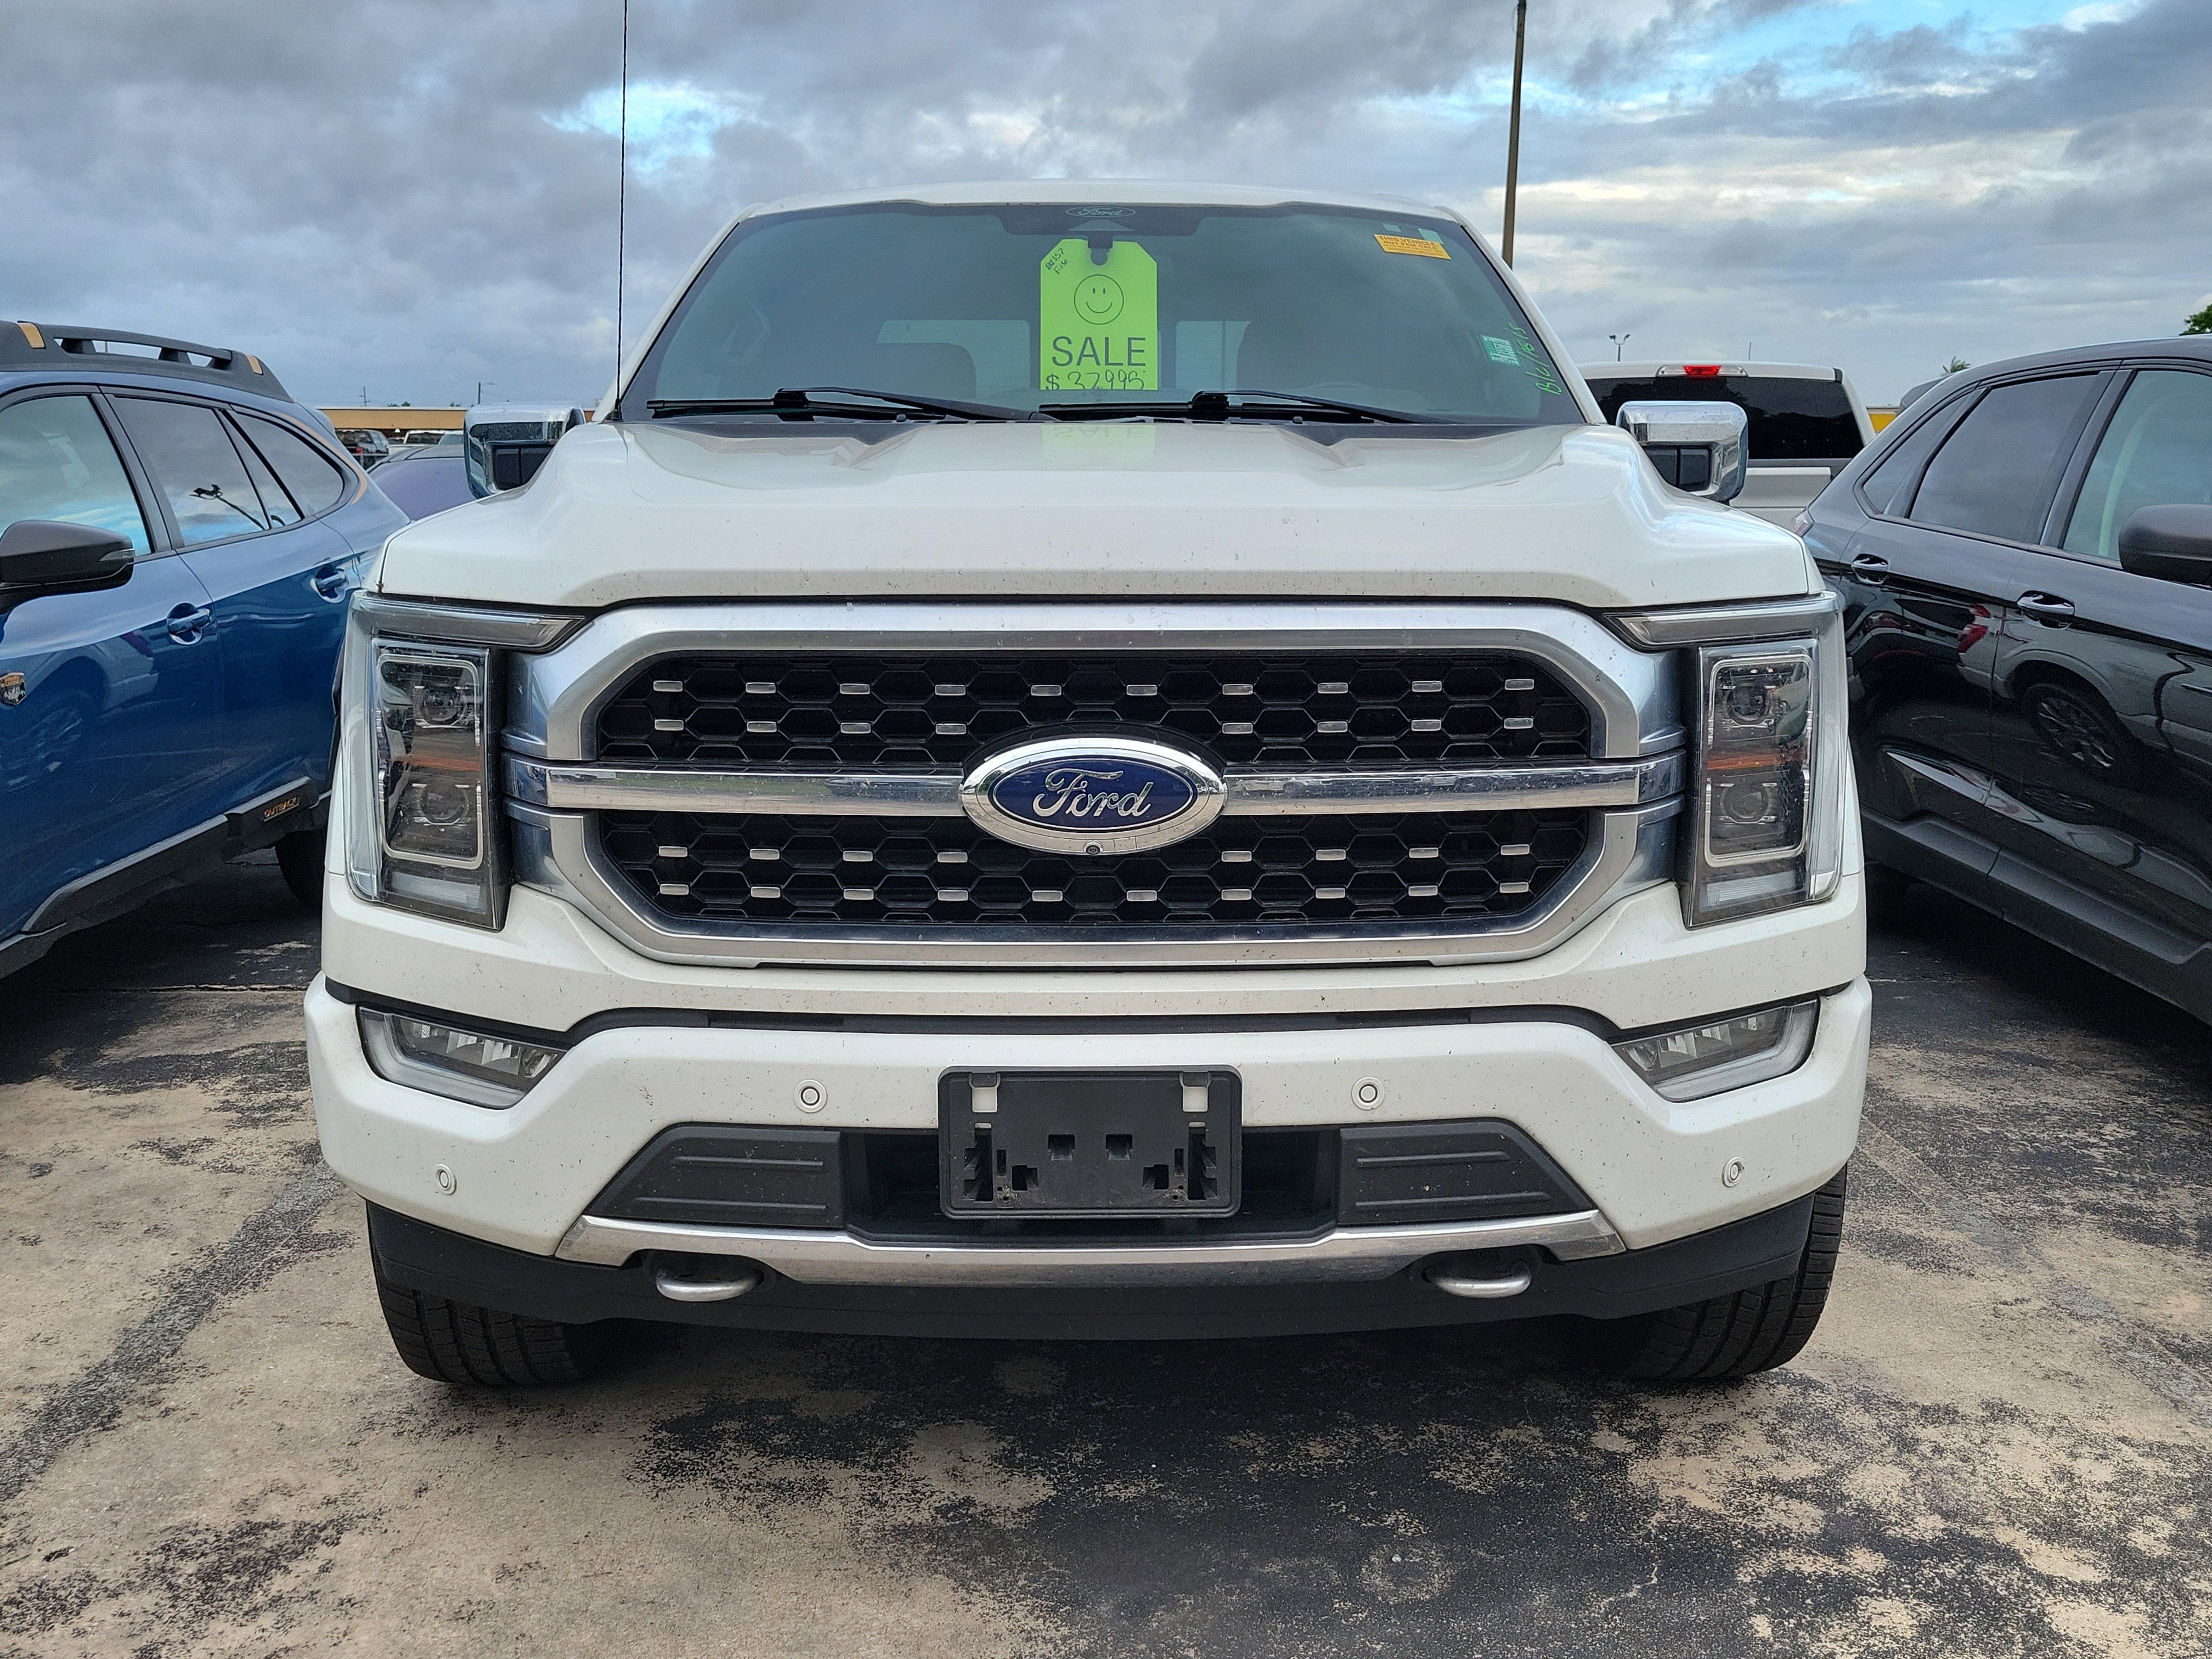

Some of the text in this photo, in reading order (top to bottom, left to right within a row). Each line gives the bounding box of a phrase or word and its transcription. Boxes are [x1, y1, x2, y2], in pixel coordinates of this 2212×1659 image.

[1078, 207, 1124, 216] Ford
[1052, 336, 1146, 366] SALE
[1032, 769, 1154, 817] Ford
